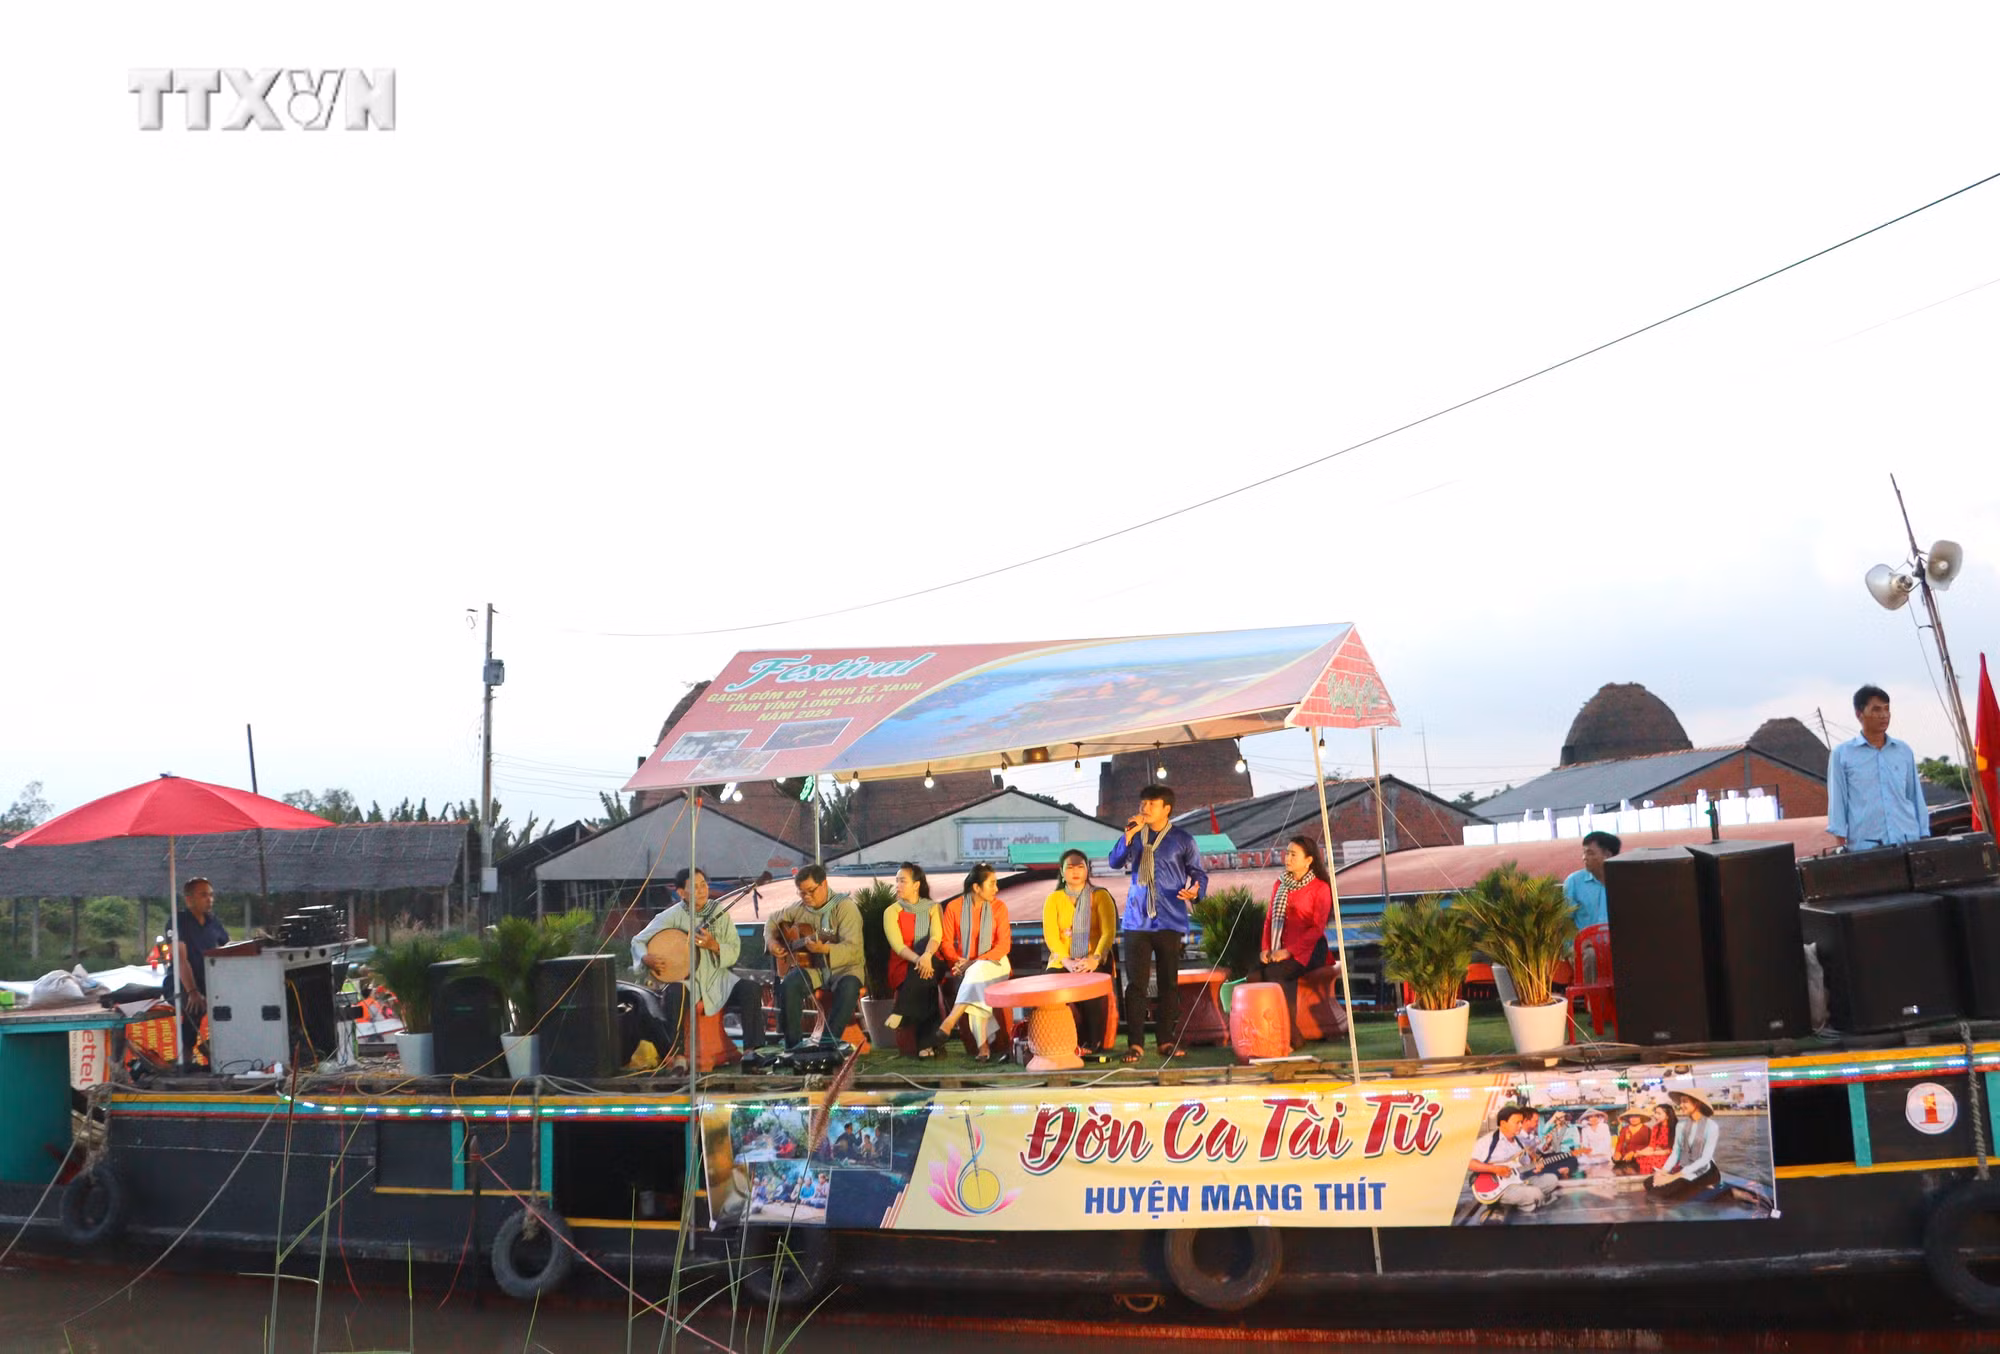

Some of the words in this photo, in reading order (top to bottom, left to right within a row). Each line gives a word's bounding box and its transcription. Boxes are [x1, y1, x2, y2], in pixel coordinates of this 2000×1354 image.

[724, 651, 938, 692] Festival
[707, 692, 748, 704] GẠCH
[750, 688, 786, 700] GỐM
[786, 687, 809, 699] ĐỎ
[819, 686, 858, 698] KINH
[880, 682, 924, 693] XANH
[800, 697, 842, 709] LONG
[795, 708, 833, 719] 2024
[1020, 1103, 1153, 1175] Đờn
[1163, 1102, 1249, 1162] Ca
[1259, 1098, 1352, 1162] Tài
[1364, 1092, 1443, 1158] Tử
[1084, 1180, 1190, 1218] HUYỆN
[1201, 1183, 1302, 1212] MANG
[1314, 1176, 1387, 1211] THÍT
